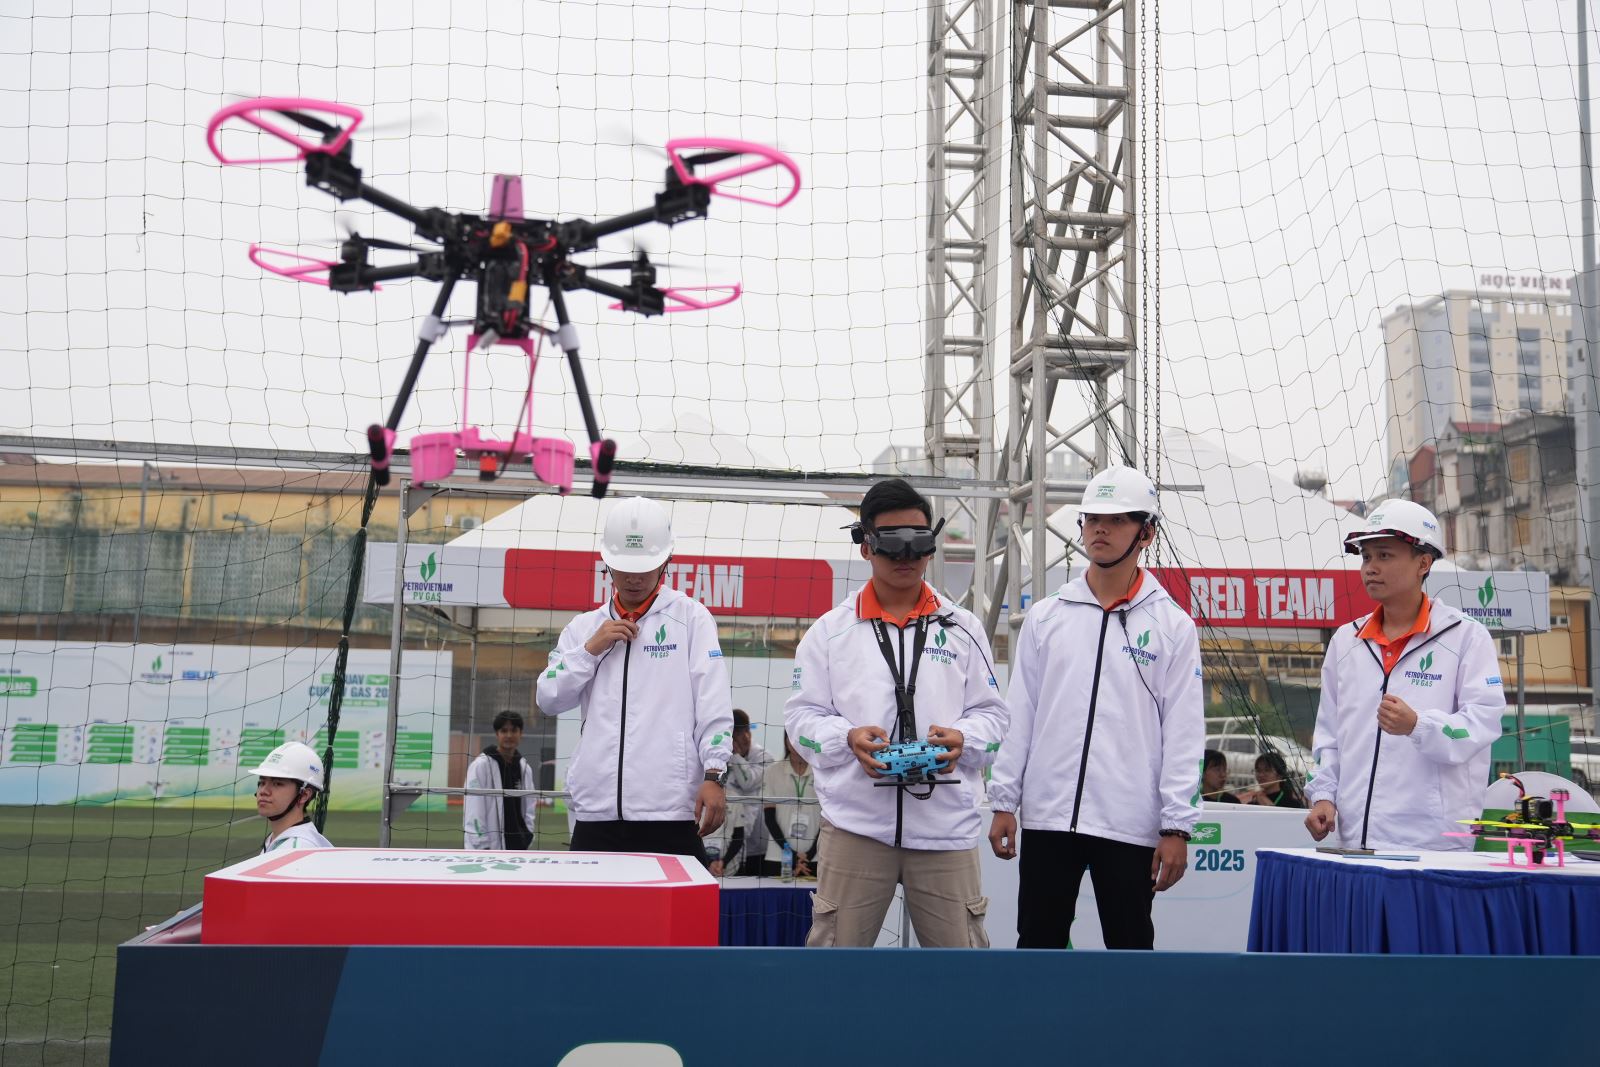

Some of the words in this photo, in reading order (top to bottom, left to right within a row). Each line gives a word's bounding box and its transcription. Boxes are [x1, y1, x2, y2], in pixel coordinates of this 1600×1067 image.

[1481, 274, 1516, 288] HỌC
[403, 582, 453, 592] PETROVIETNAM
[664, 563, 744, 608] TEAM
[413, 592, 424, 600] PV
[425, 592, 441, 601] GAS
[1190, 577, 1245, 619] RED
[1254, 577, 1335, 620] TEAM
[1462, 608, 1512, 617] PETROVIETNAM
[1486, 617, 1502, 626] GAS
[643, 644, 677, 652] PETROVIETNAM
[660, 651, 670, 659] GAS
[922, 647, 957, 660] PETROVIETNAM
[1122, 645, 1157, 662] PETROVIETNAM
[940, 655, 952, 665] GAS
[1137, 656, 1150, 666] GAS
[1404, 670, 1442, 681] PETROVIETNAM
[1411, 678, 1419, 686] PV
[1420, 679, 1433, 687] GAS
[350, 686, 371, 698] GAS
[375, 686, 388, 698] 20
[1195, 849, 1245, 871] 2025
